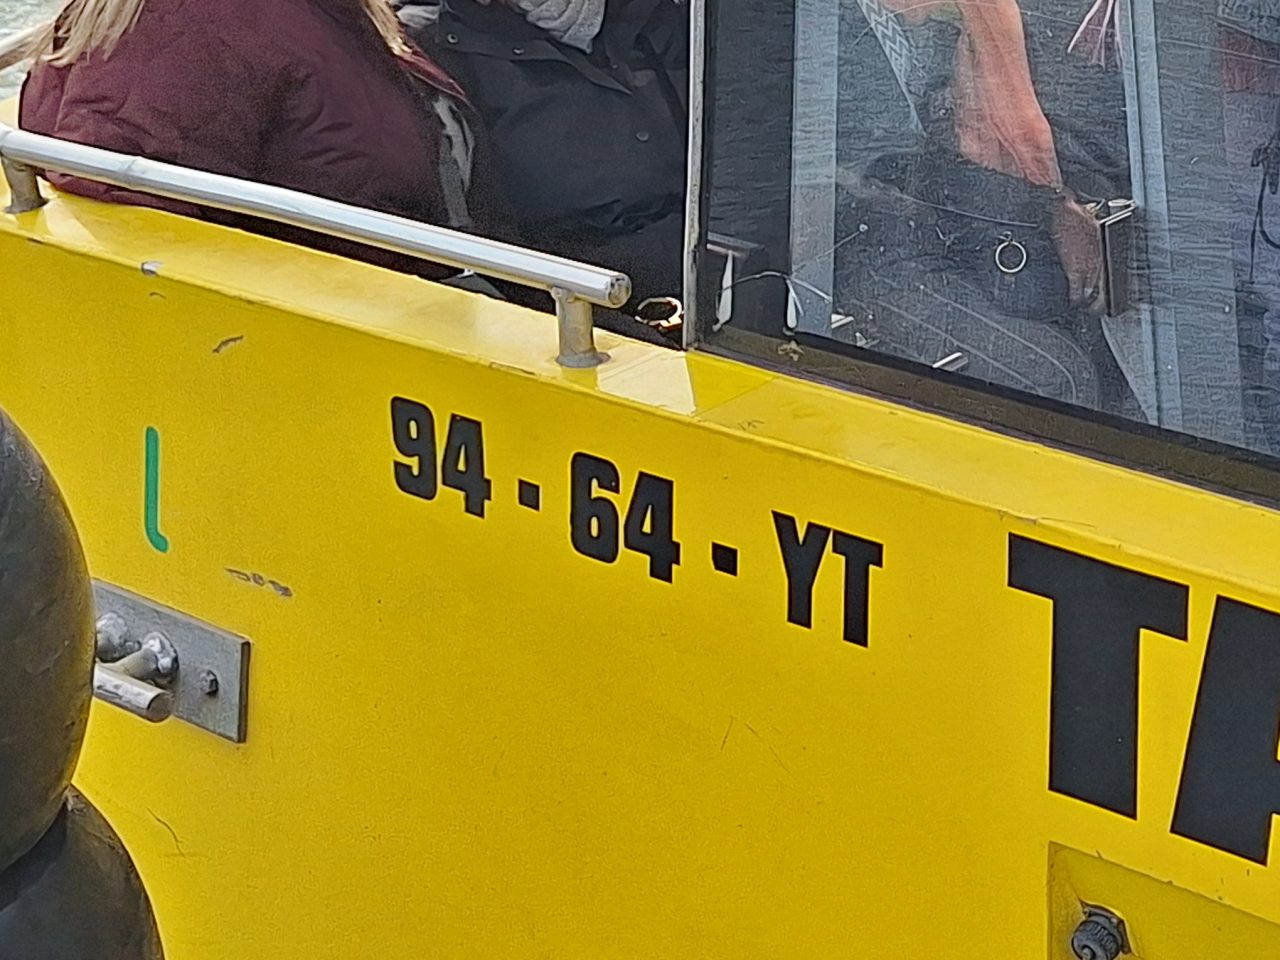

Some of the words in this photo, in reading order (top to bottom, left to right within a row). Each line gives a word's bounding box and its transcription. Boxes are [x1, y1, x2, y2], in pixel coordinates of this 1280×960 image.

[390, 396, 492, 519] 94
[570, 451, 681, 584] 64
[771, 509, 884, 648] YT
